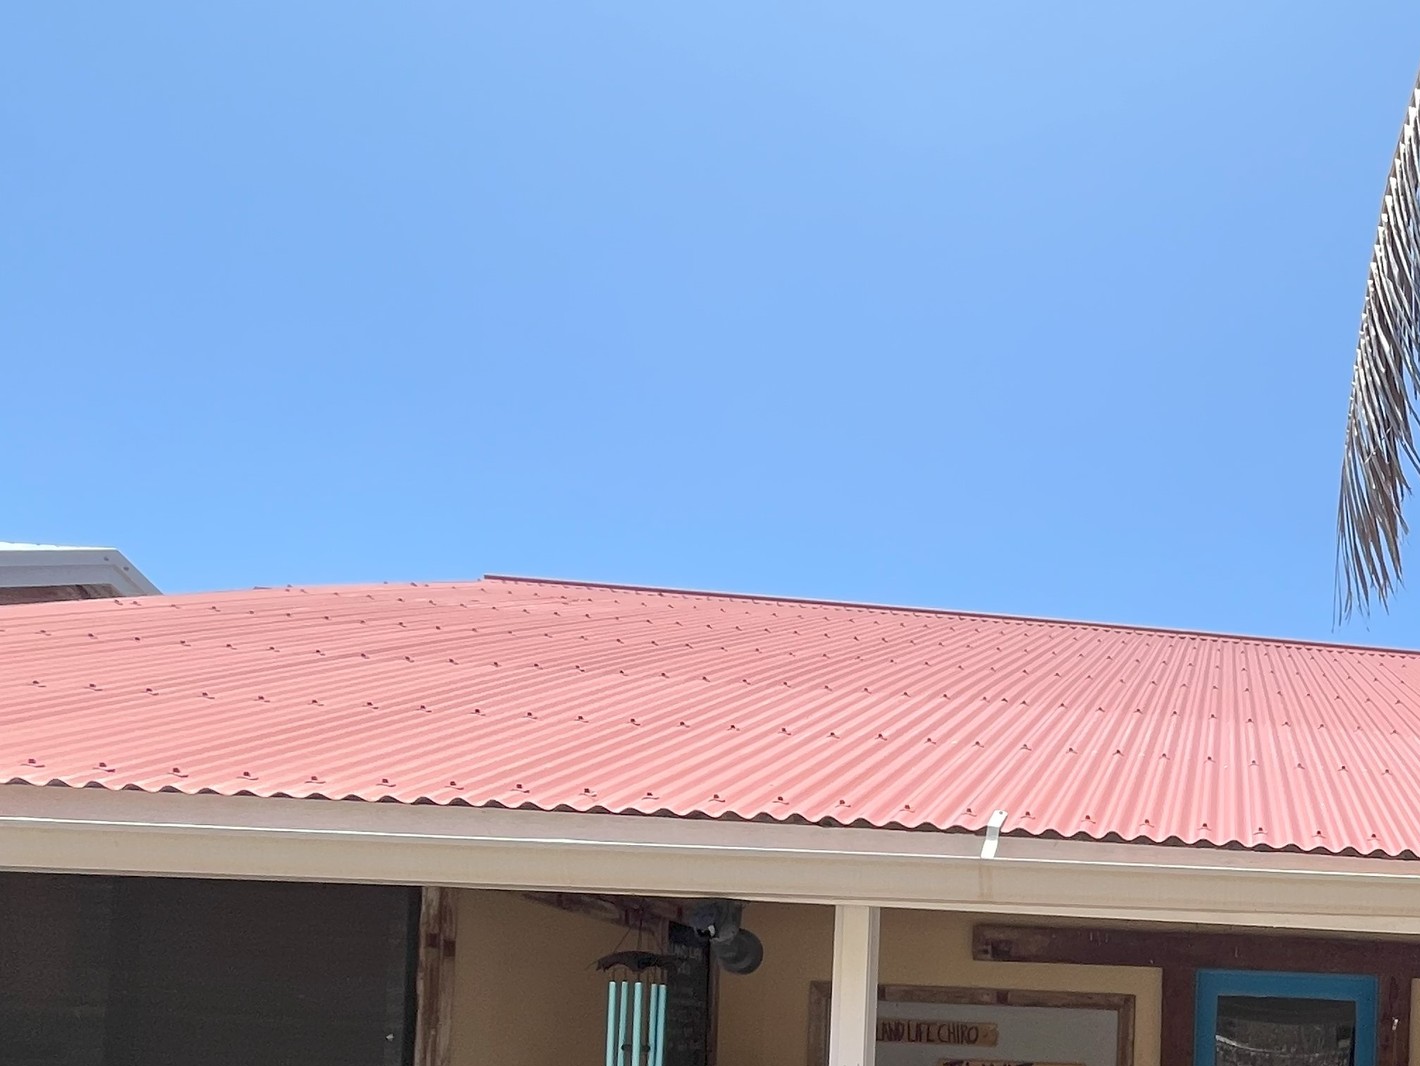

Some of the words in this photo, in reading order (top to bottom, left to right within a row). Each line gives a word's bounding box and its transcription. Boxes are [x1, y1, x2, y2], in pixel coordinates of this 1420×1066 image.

[876, 1021, 905, 1042] LAND
[906, 1021, 936, 1043] LIFE
[937, 1022, 980, 1046] CHIRO
